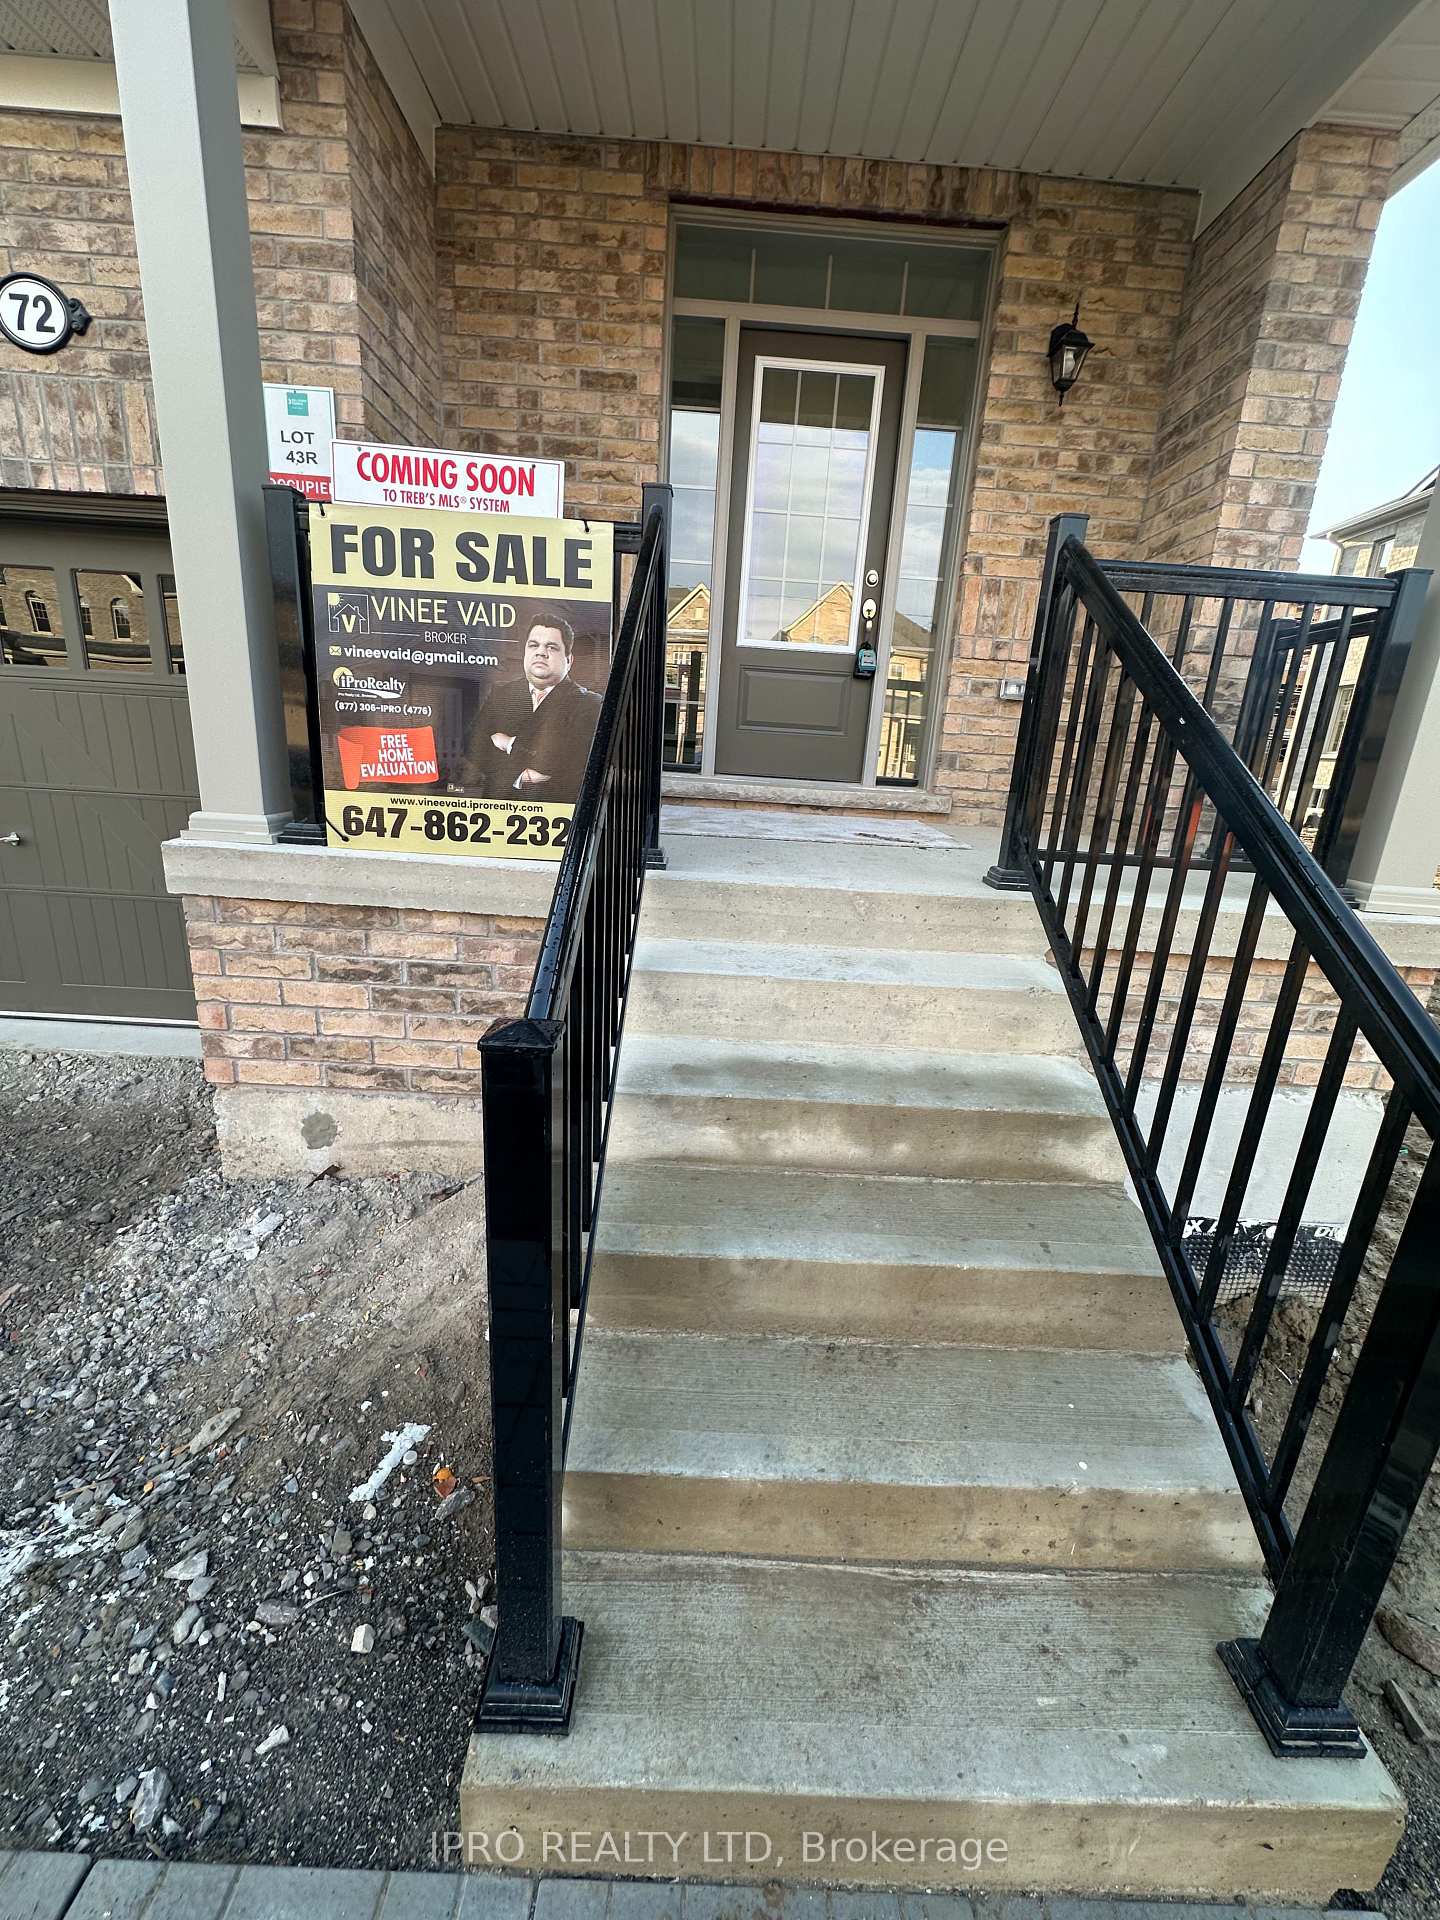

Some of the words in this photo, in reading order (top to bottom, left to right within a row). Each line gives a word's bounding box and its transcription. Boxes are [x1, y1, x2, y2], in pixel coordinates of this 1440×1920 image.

[9, 293, 56, 333] 72
[281, 430, 315, 444] LOT
[286, 450, 318, 465] 43R
[356, 451, 458, 490] COMING
[466, 462, 535, 497] SOON
[270, 478, 331, 495] CUPIE
[383, 488, 397, 503] TO
[401, 490, 435, 506] TREB'S
[470, 497, 510, 513] SYSTEM
[330, 524, 435, 580] FOR
[455, 531, 593, 590] SALE
[371, 595, 448, 625] VINEE
[457, 600, 516, 628] VAID
[424, 630, 467, 645] BROKER
[344, 645, 498, 666] vineevaid@gmail.com
[341, 675, 406, 695] iProRealty
[334, 700, 358, 712] (877)
[359, 702, 402, 713] 306-IPRO
[403, 704, 432, 717] (4776)
[380, 734, 408, 749] FREE
[378, 747, 415, 763] HOME
[360, 760, 436, 777] EVALUATION
[390, 797, 543, 813] www.vineevaid.iprorealty.com
[342, 805, 571, 847] 647-862-232
